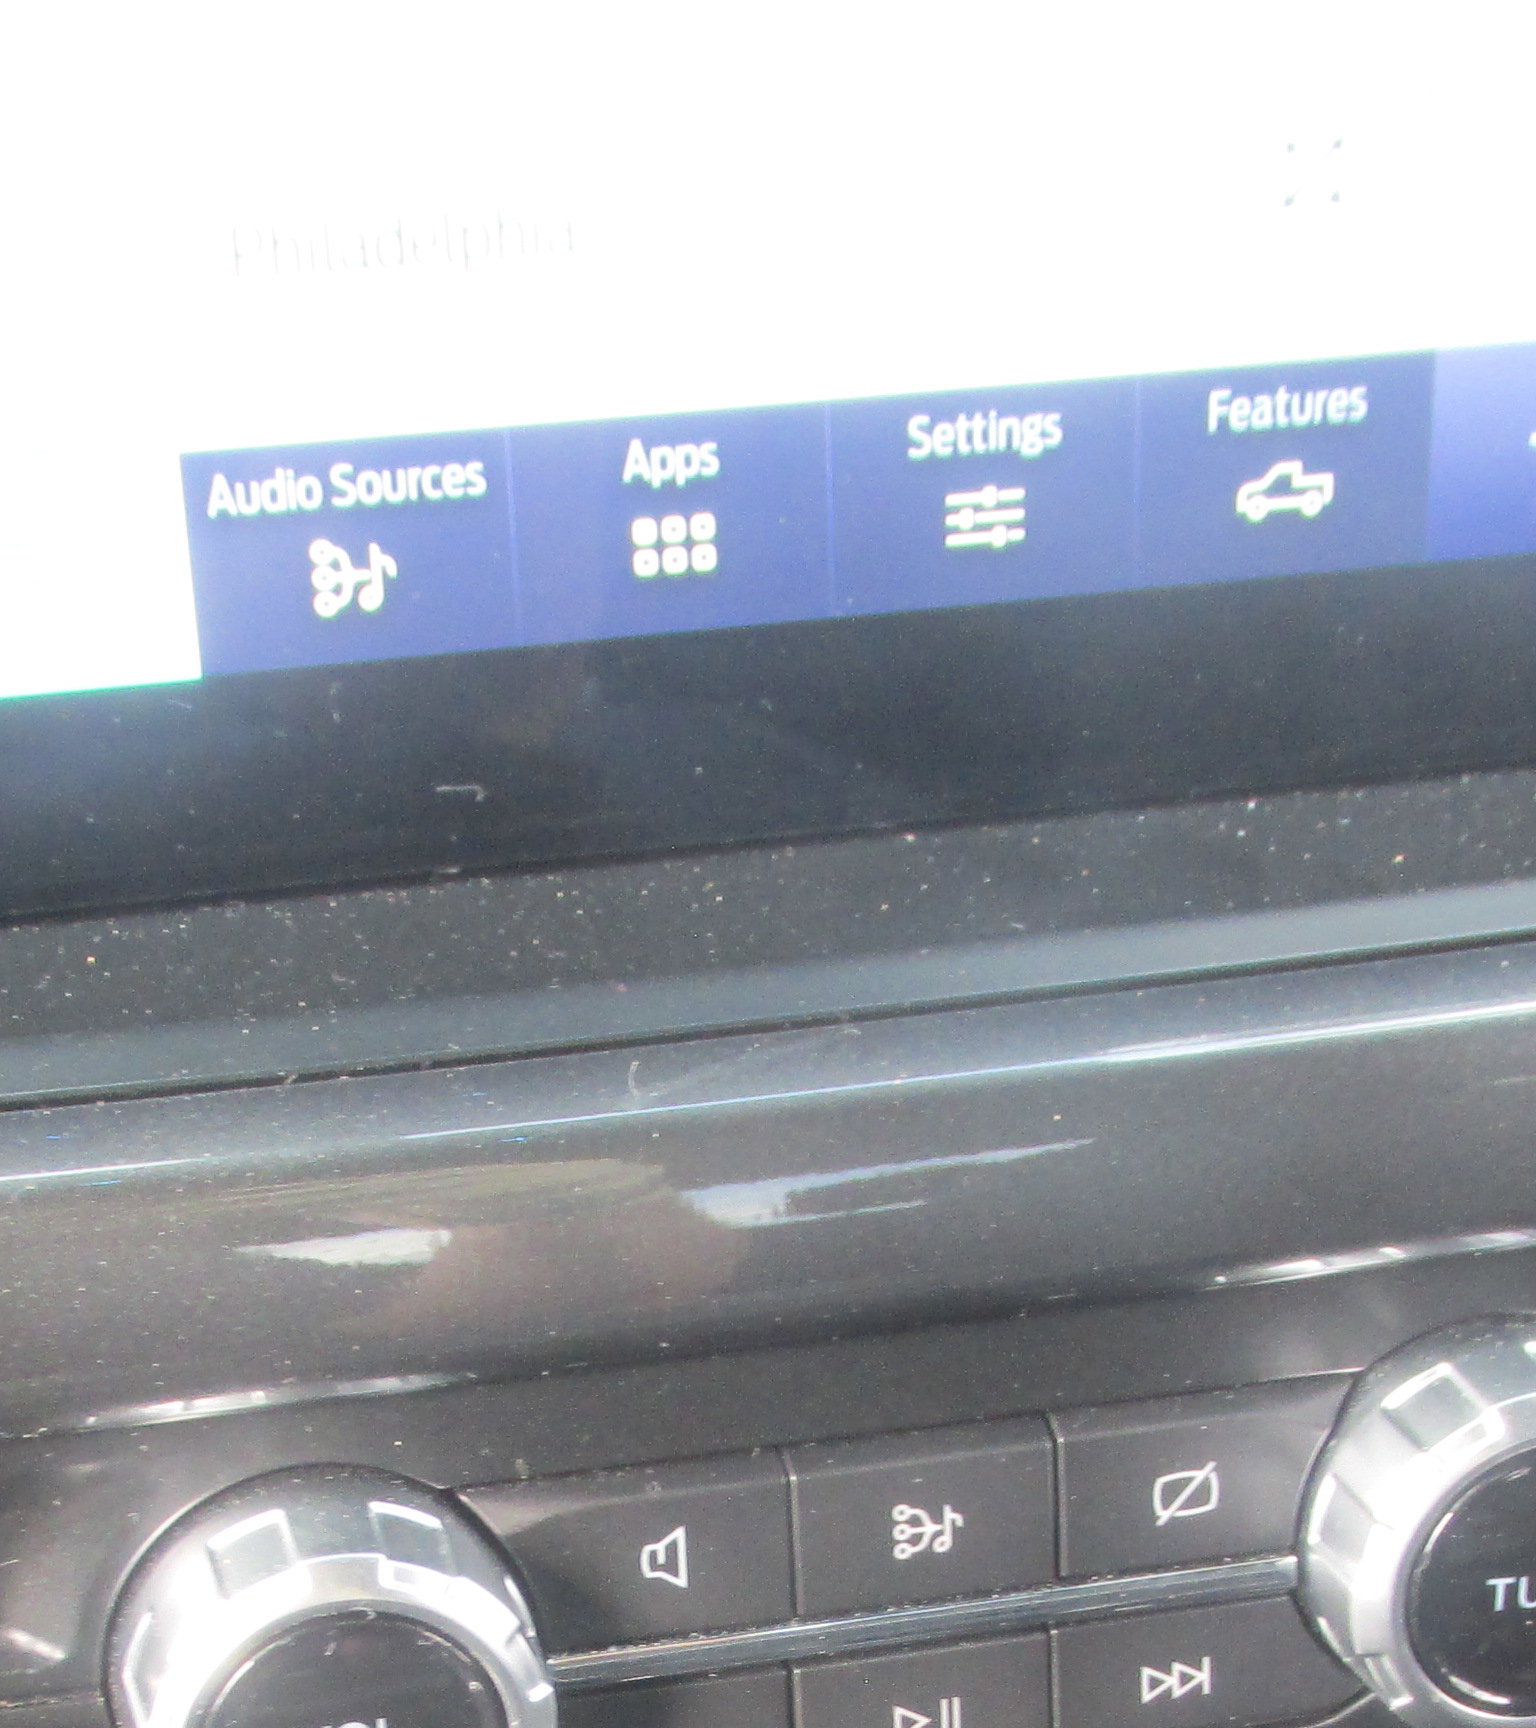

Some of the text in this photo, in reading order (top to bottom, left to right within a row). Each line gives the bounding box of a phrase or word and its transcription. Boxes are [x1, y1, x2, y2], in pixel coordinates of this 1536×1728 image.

[905, 405, 1067, 465] Settings
[1206, 383, 1371, 434] Features
[205, 460, 488, 520] Audio Sources
[621, 435, 722, 492] Apps
